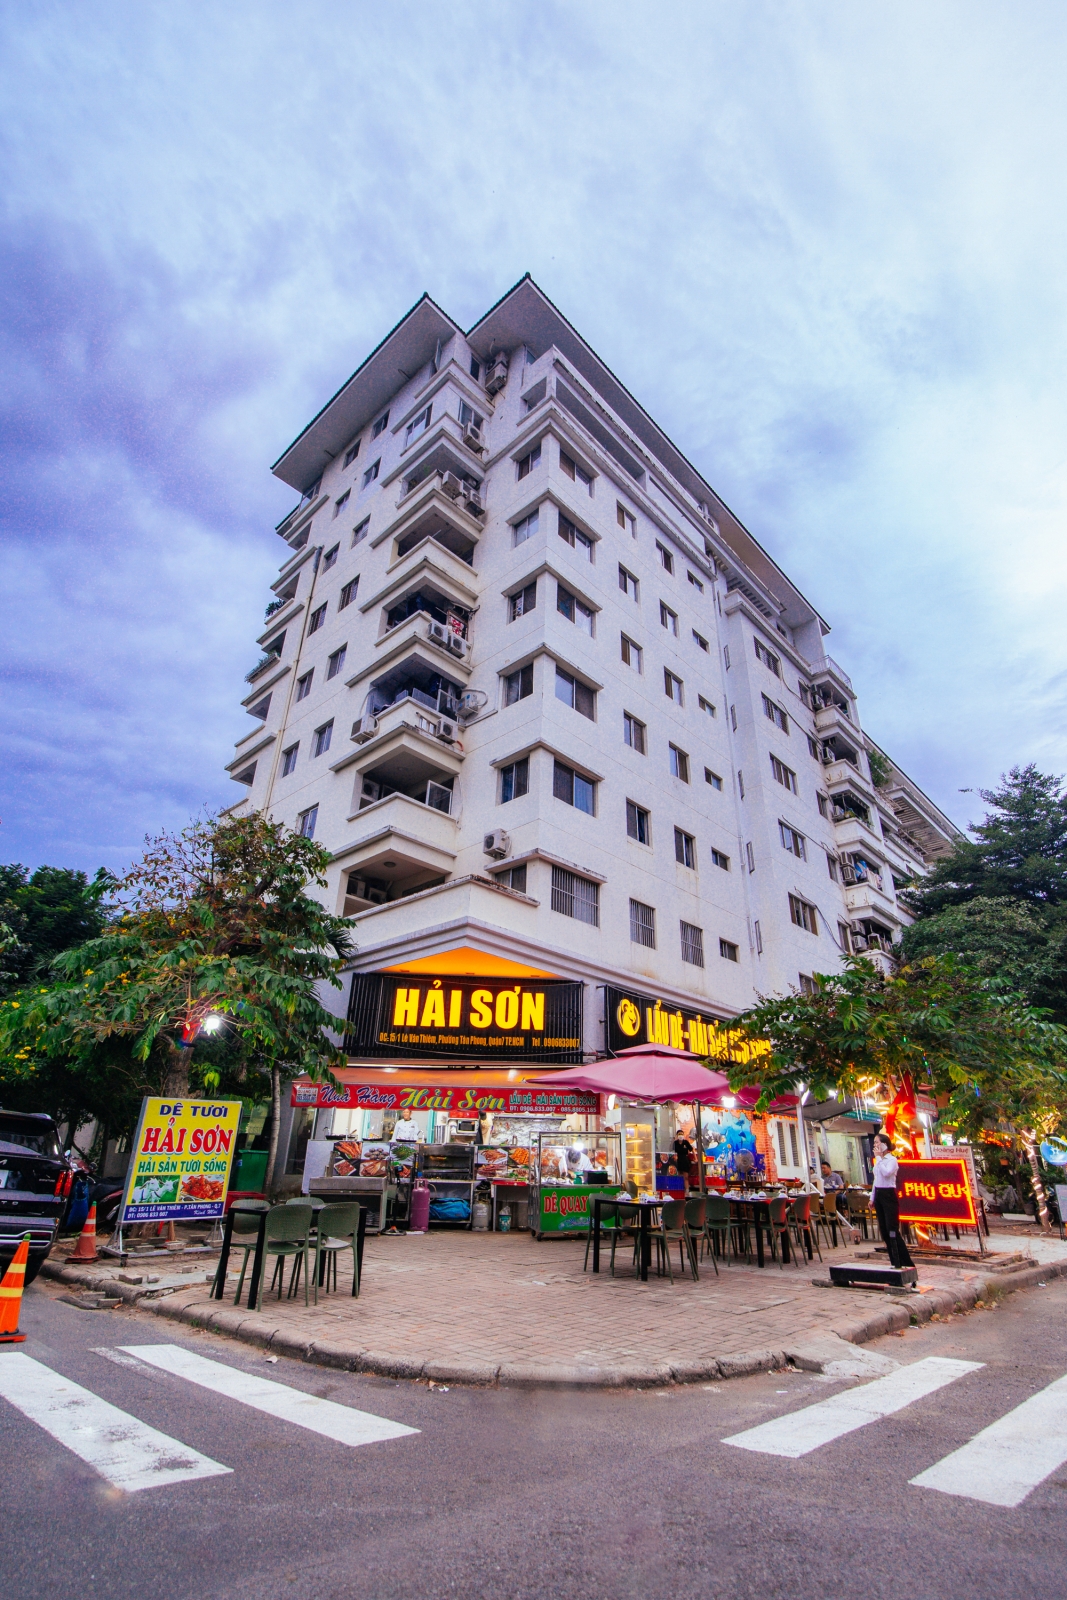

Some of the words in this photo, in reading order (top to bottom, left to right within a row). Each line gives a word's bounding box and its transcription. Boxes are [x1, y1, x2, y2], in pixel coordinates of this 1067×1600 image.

[393, 980, 462, 1028] HẢI
[469, 986, 545, 1031] SƠN
[646, 999, 669, 1046] LẨU
[160, 1102, 183, 1116] DÊ
[191, 1104, 228, 1117] TƯƠI
[357, 1086, 397, 1108] Hàng
[400, 1087, 453, 1109] Hải
[458, 1089, 507, 1111] Sơn
[521, 1092, 531, 1105] DÊ
[536, 1092, 548, 1105] HẢI
[549, 1092, 562, 1105] SẢN
[141, 1117, 187, 1154] HẢI
[189, 1124, 233, 1154] SƠN
[138, 1157, 155, 1173] HẢI
[158, 1157, 177, 1173] SẢN
[180, 1159, 201, 1172] TƯƠI
[203, 1157, 227, 1172] SỐNG
[544, 1192, 558, 1213] DÊ
[560, 1195, 589, 1216] QUAY
